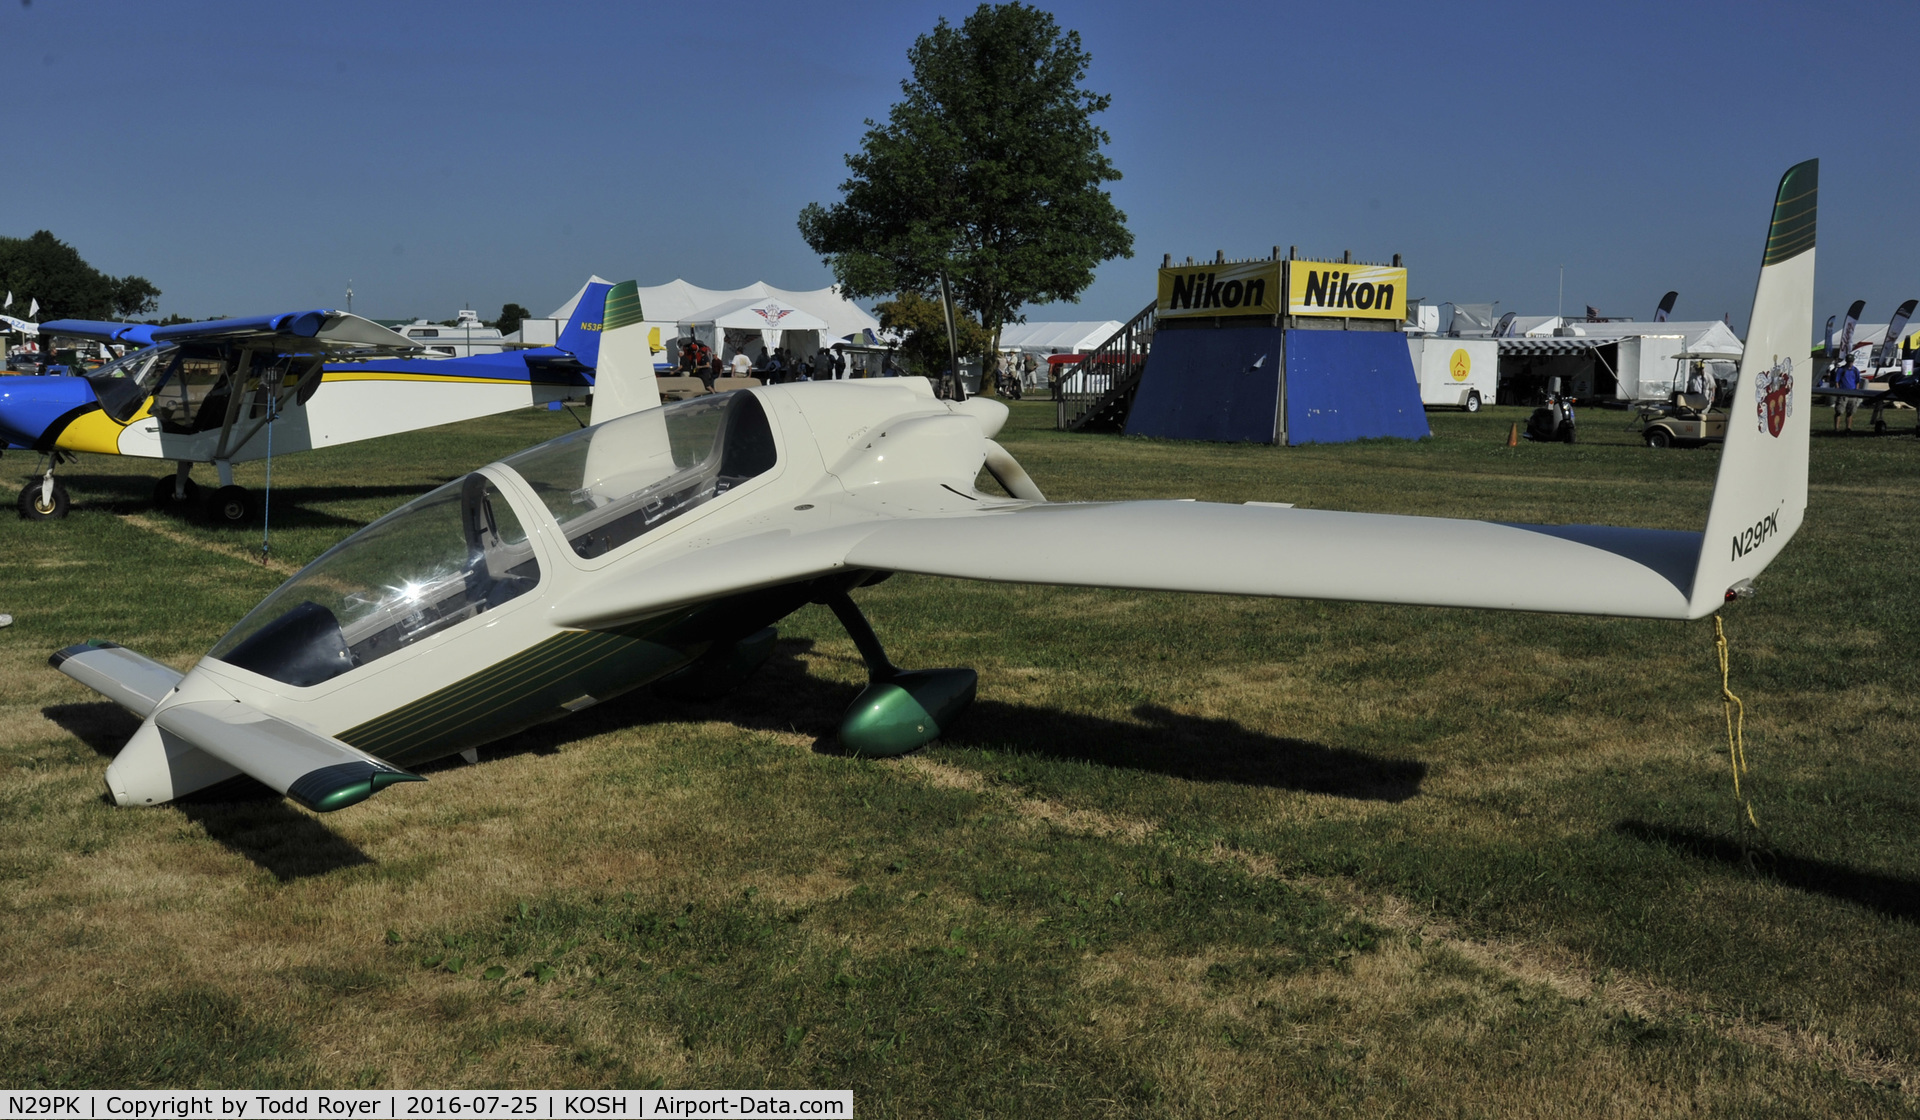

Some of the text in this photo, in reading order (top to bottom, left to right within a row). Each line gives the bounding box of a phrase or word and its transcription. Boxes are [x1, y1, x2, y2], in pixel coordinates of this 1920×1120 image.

[1170, 273, 1265, 310] Nikon
[1304, 271, 1394, 310] Nikon
[1731, 507, 1780, 562] N29PK
